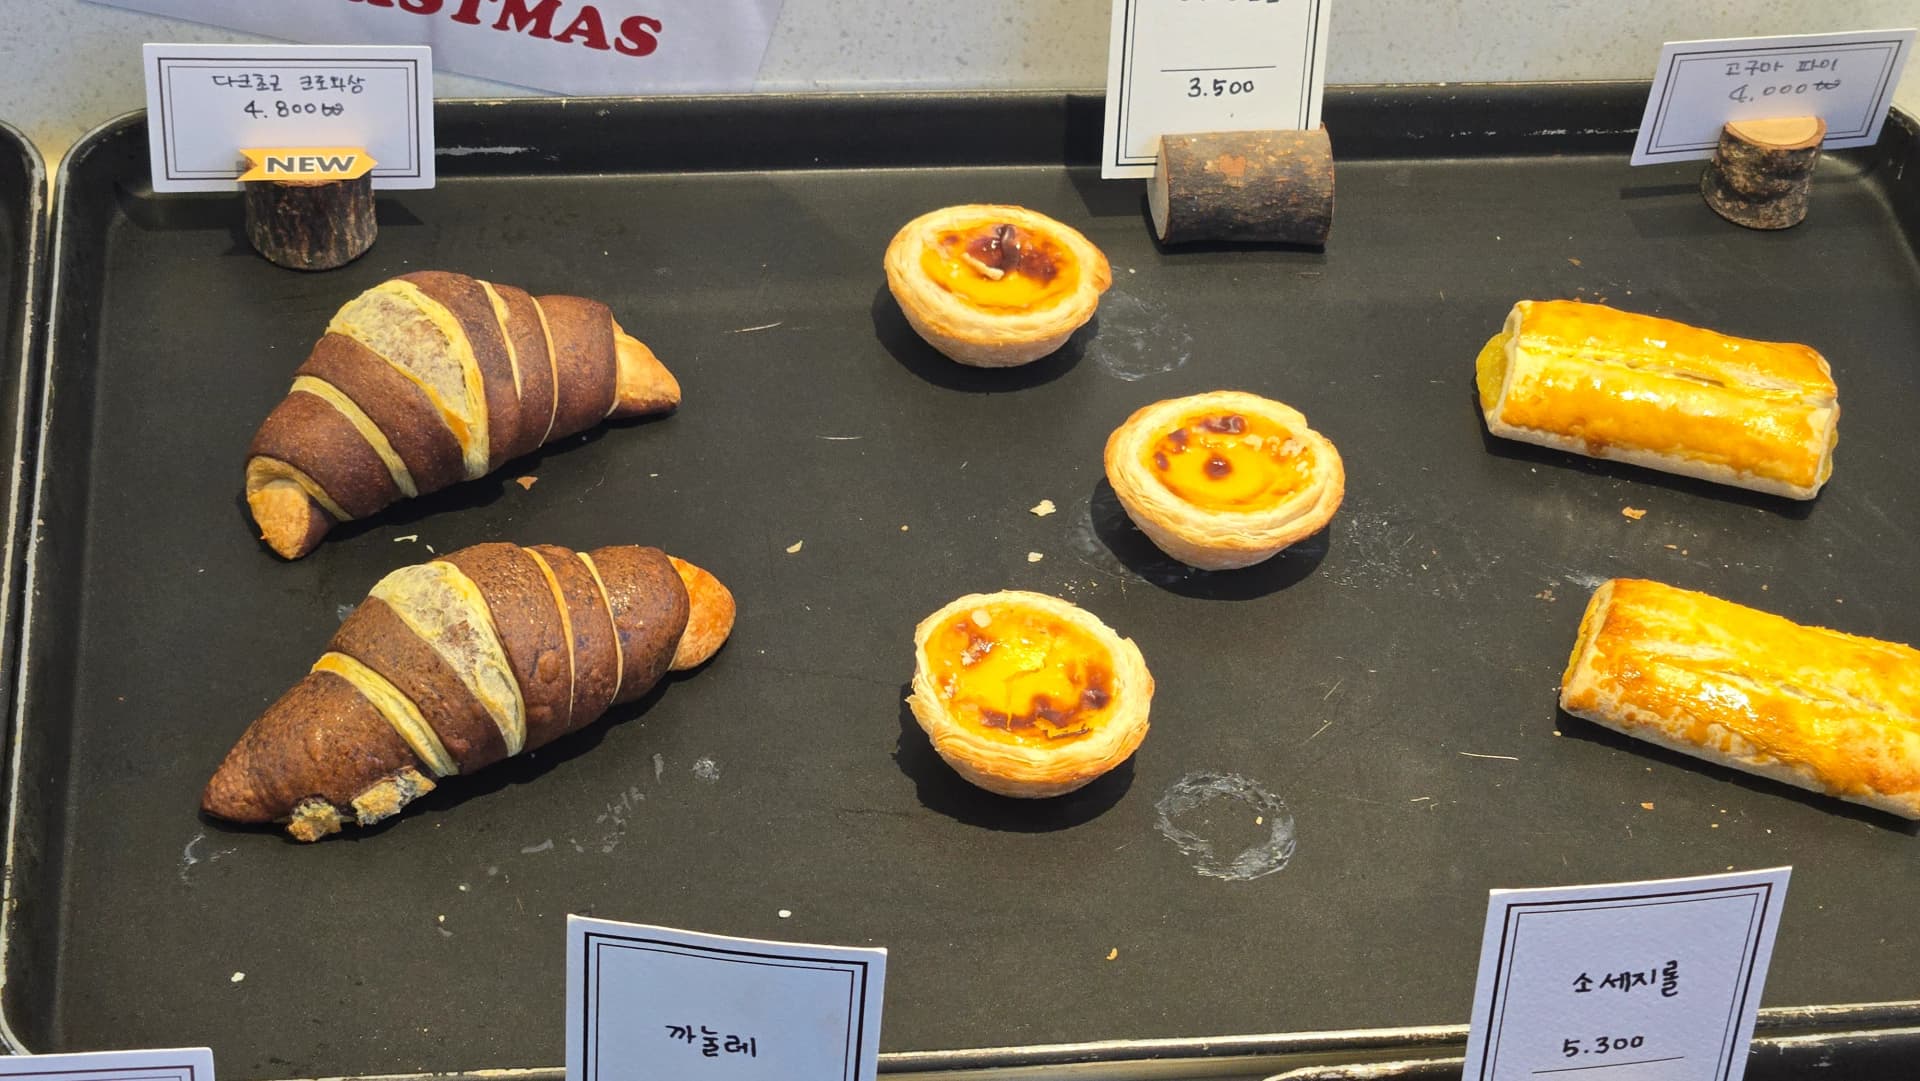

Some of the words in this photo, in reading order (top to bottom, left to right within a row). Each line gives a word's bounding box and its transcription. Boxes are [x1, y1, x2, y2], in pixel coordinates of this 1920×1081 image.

[1796, 58, 1840, 73] 파이
[299, 74, 366, 94] 크로와상
[1187, 76, 1255, 98] 3.500
[266, 156, 355, 173] NEW
[1572, 960, 1680, 998] 소세지롤
[665, 1024, 757, 1058] 까눌레
[1561, 1034, 1645, 1058] 5.300
